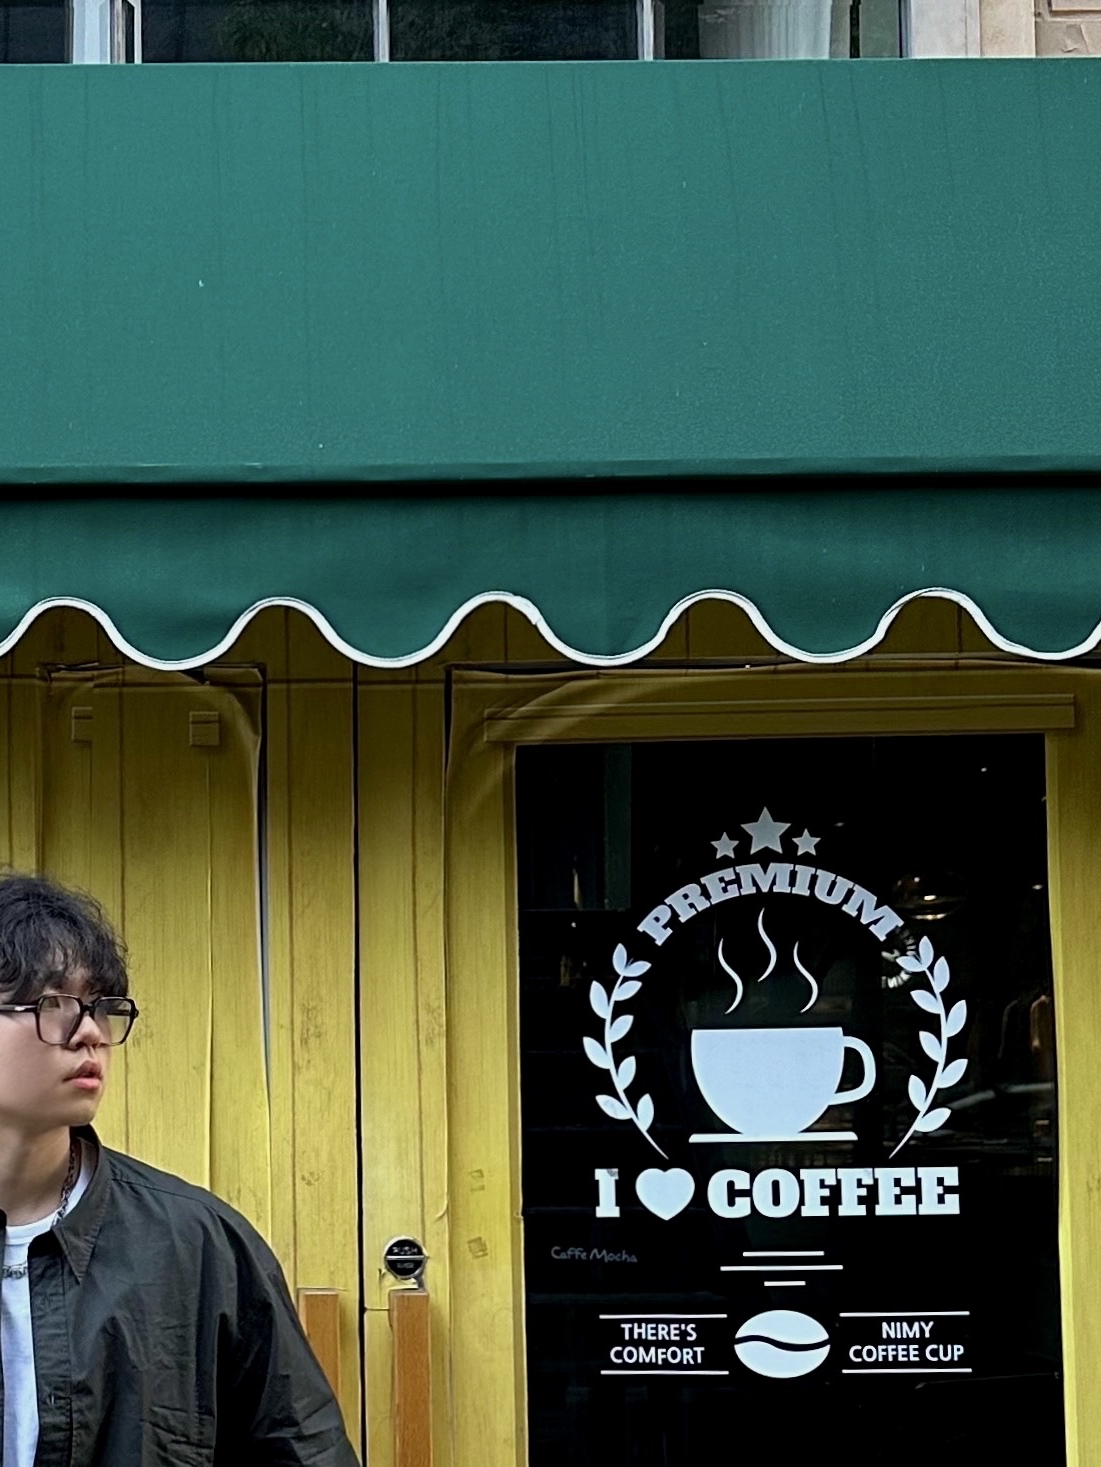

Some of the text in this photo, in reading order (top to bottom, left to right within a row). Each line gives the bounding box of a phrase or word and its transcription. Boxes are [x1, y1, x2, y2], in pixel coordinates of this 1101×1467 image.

[637, 863, 904, 946] PREMIUM
[594, 1166, 960, 1219] I COFFEE
[589, 1247, 638, 1263] Mocha
[620, 1323, 697, 1342] THERE'S
[609, 1346, 705, 1365] COMFORT
[848, 1344, 965, 1363] COFFEE CUP
